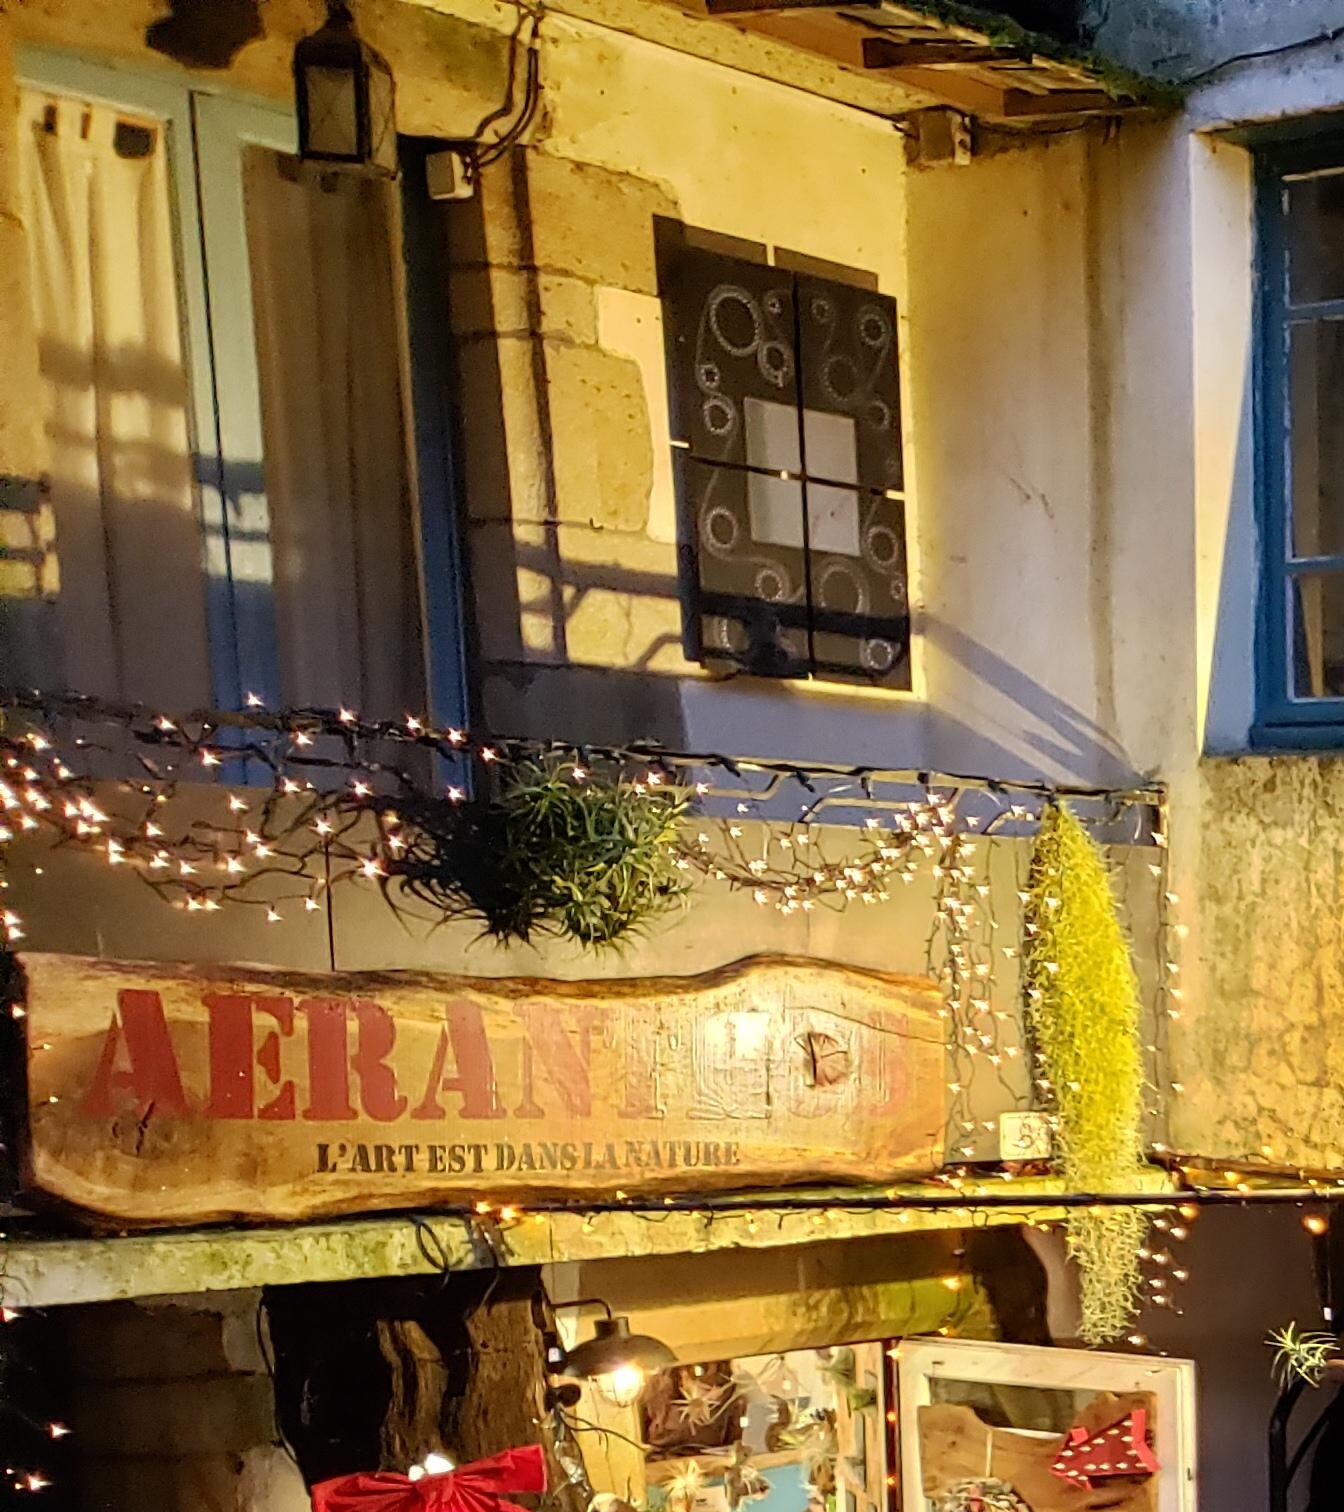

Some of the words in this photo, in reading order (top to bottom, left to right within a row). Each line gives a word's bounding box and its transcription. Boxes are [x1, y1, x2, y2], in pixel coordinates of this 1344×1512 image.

[315, 1143, 420, 1174] L'ART
[427, 1143, 488, 1173] EST
[494, 1142, 579, 1172] DANS
[581, 1142, 623, 1171] LA
[623, 1140, 741, 1169] NATURE
